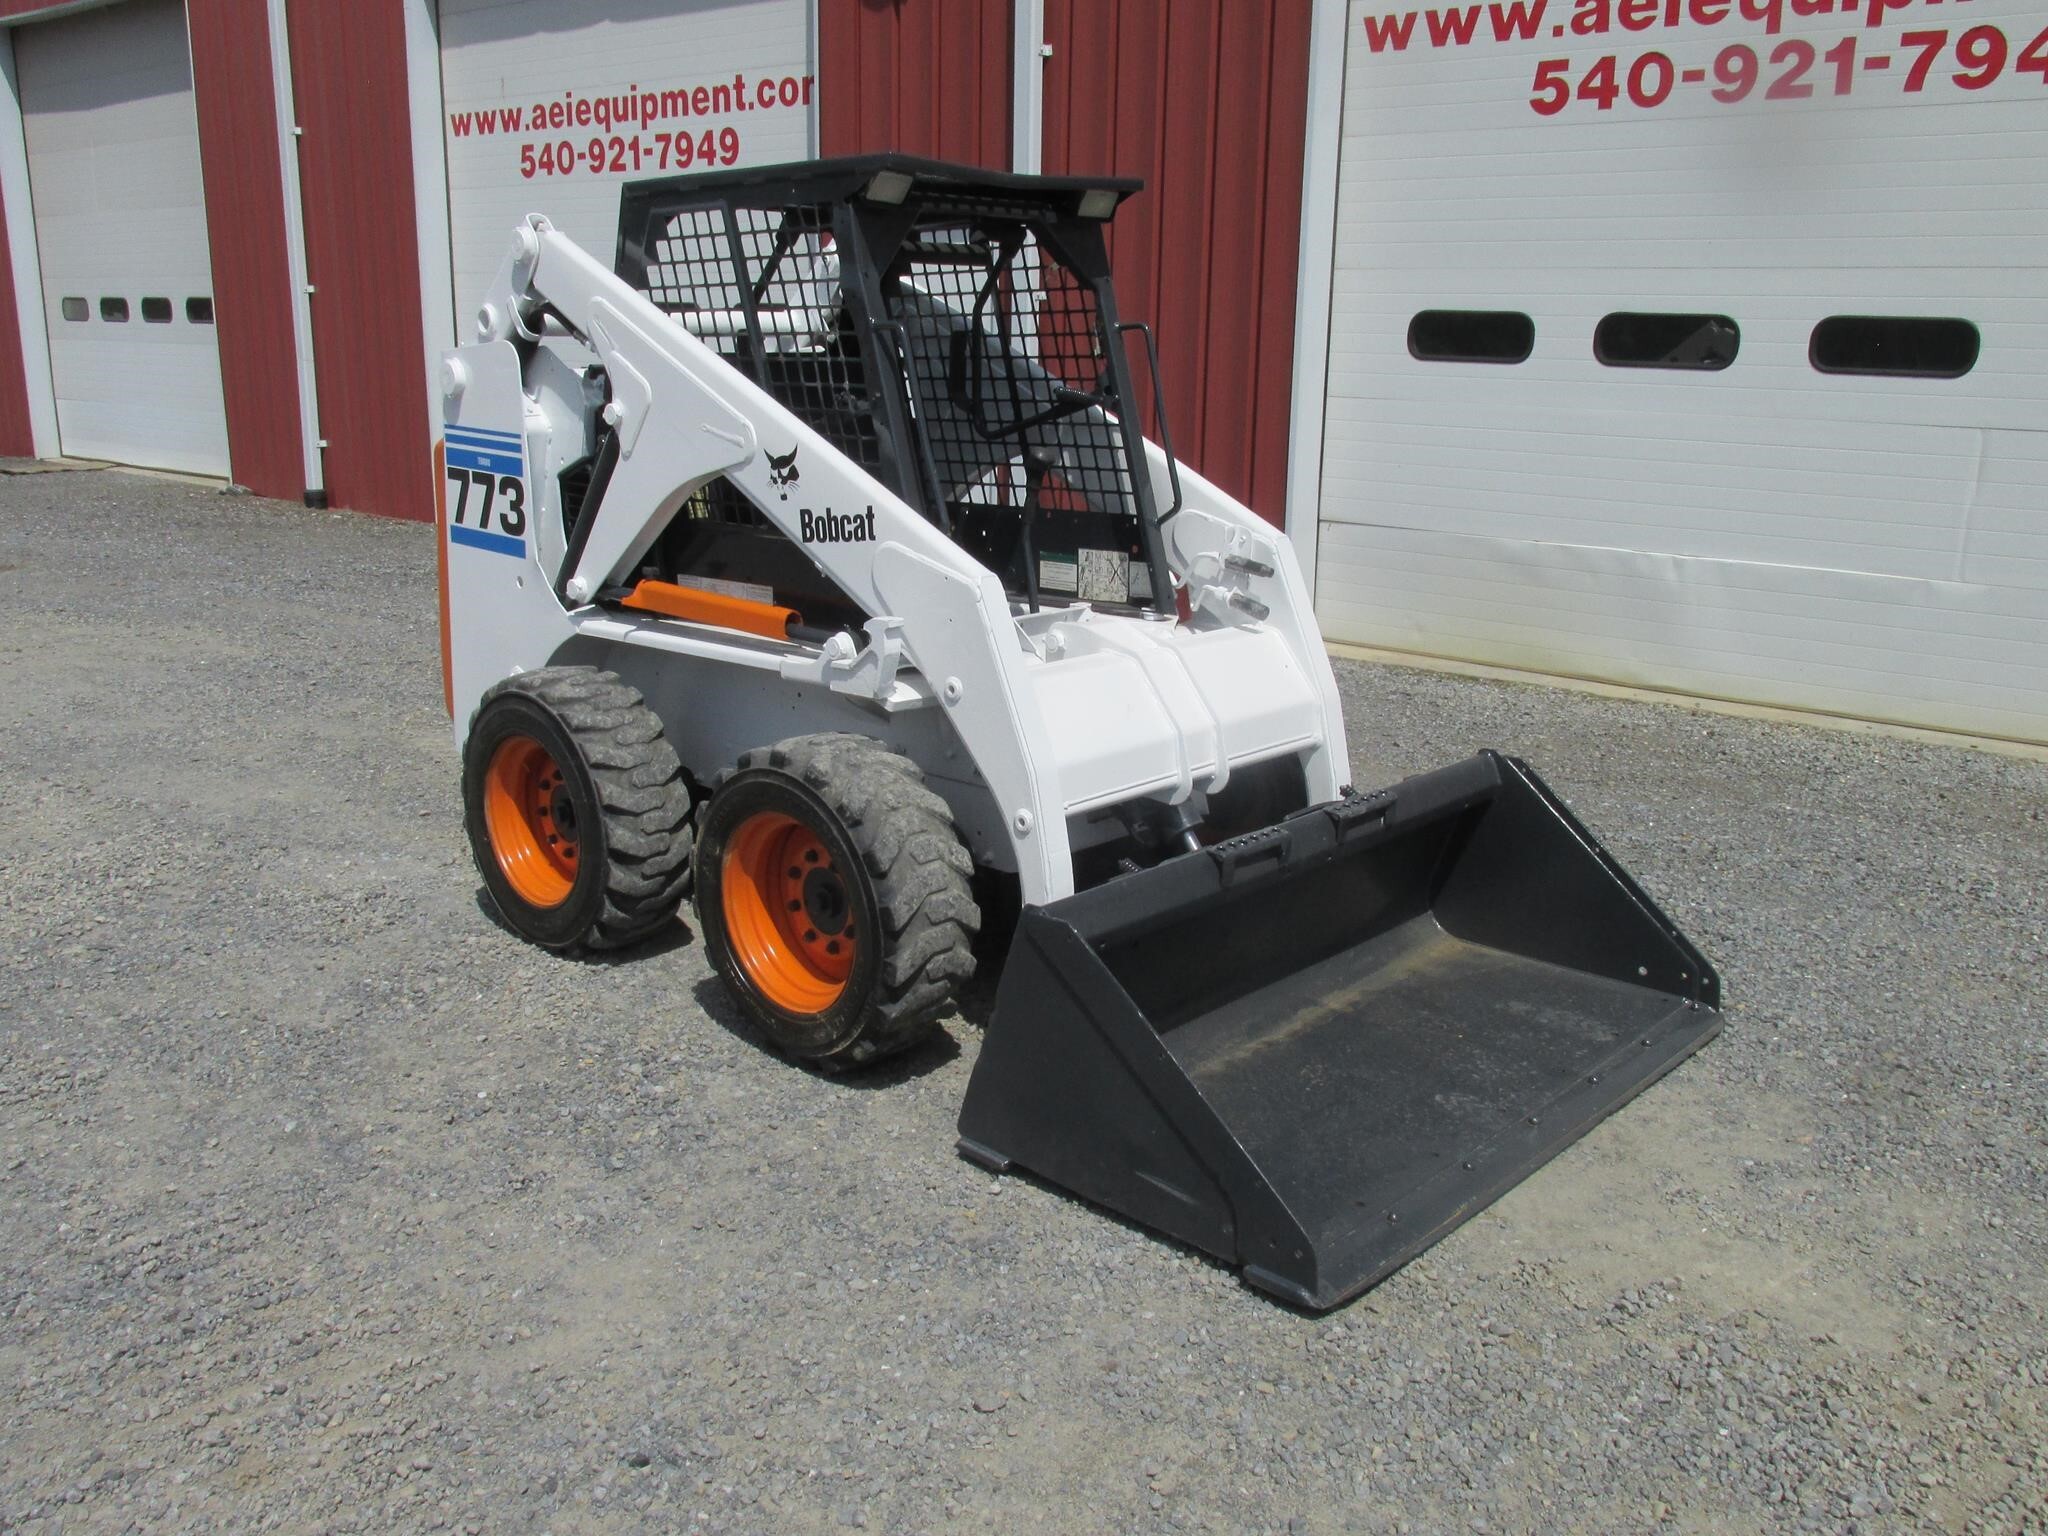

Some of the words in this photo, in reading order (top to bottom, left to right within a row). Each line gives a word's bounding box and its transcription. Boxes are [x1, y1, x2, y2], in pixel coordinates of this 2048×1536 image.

[520, 127, 740, 178] 540-921-7949
[447, 466, 526, 537] 773
[800, 505, 876, 543] Bobcat
